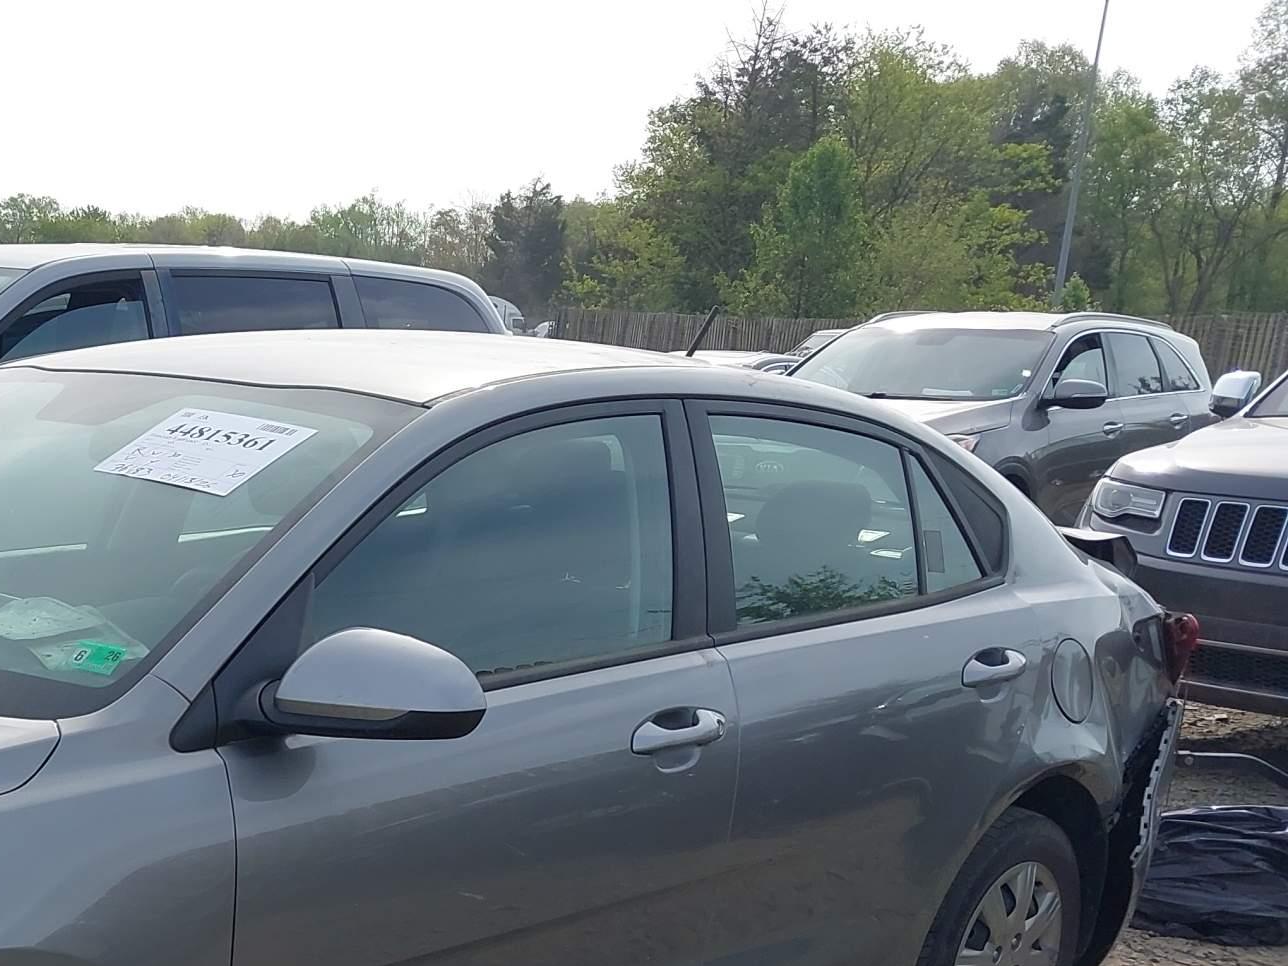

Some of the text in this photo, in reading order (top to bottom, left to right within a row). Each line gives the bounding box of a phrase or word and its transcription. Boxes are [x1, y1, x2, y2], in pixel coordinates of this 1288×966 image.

[166, 423, 277, 451] 44815361
[73, 649, 122, 662] 6 26
